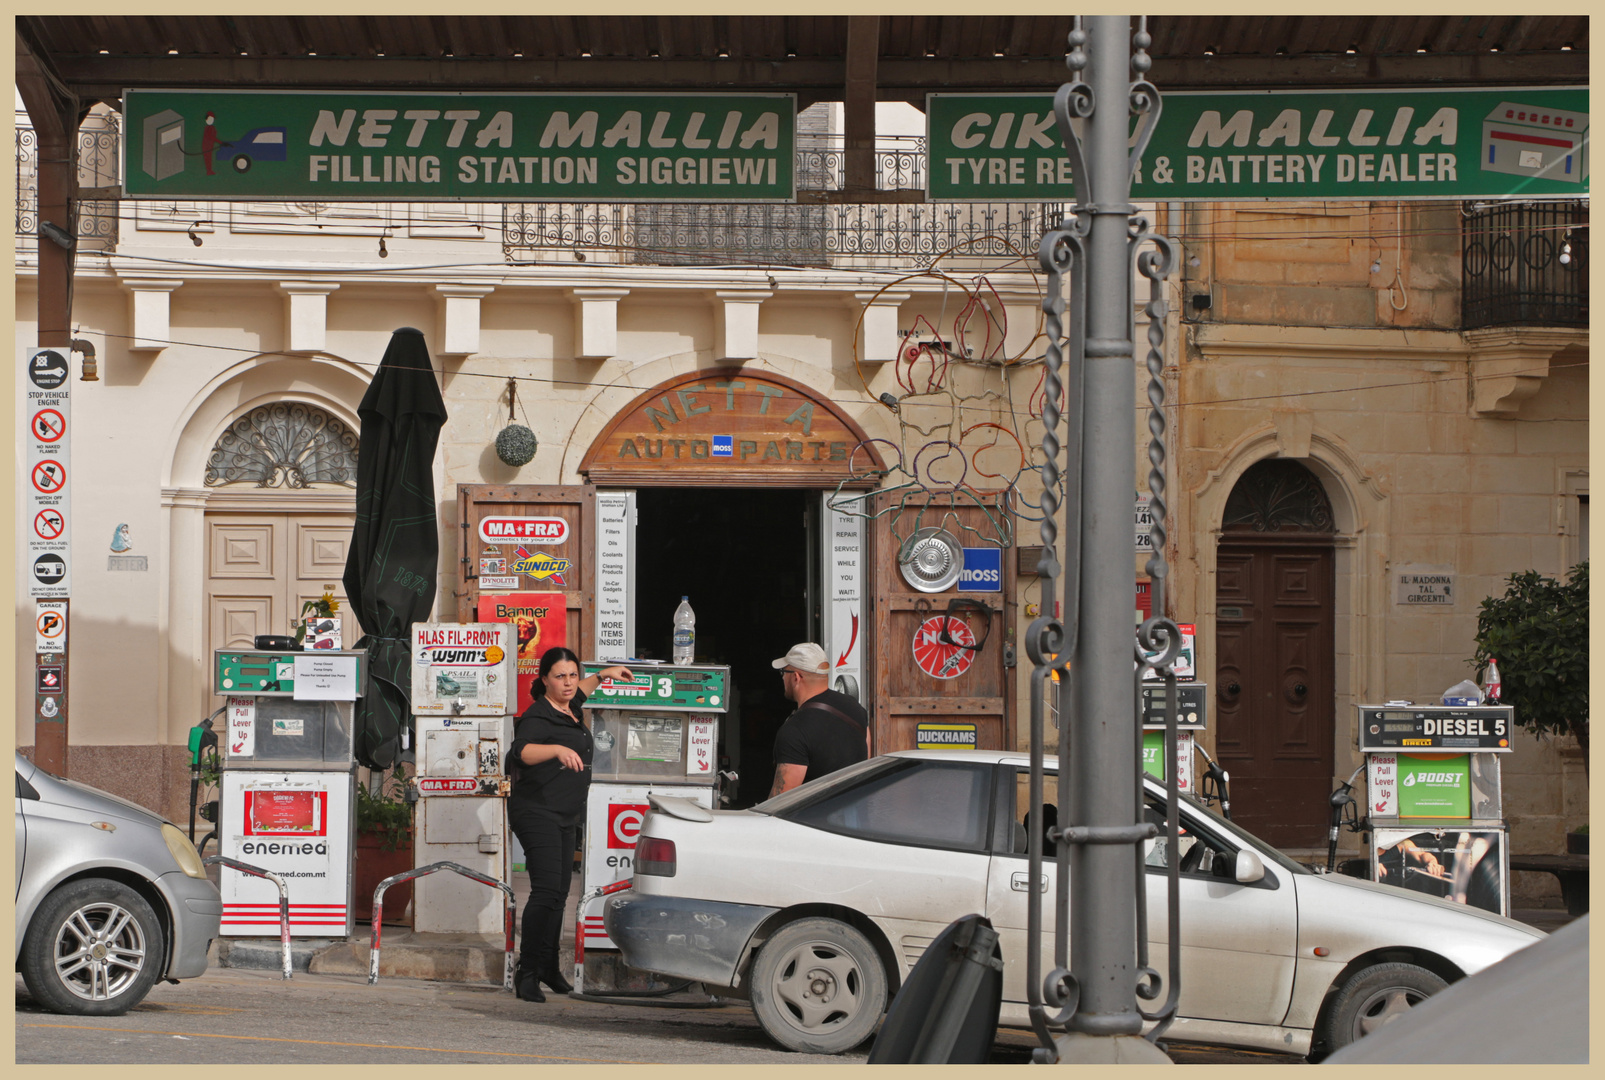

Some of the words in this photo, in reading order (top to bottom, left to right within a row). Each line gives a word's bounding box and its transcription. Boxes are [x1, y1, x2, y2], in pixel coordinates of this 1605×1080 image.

[308, 110, 513, 148] NETTA
[539, 110, 779, 149] MALLIA
[1187, 107, 1458, 147] MALLIA
[308, 155, 440, 182] FILLING
[458, 156, 597, 184] STATION
[615, 157, 777, 185] SIGGIEWI
[945, 158, 1025, 185] TYRE
[1036, 157, 1142, 184] RER
[1152, 156, 1174, 184] &
[1187, 154, 1326, 183] BATTERY
[1336, 153, 1457, 182] DEALER
[643, 381, 815, 436] NETTA
[618, 438, 709, 459] AUTO
[740, 440, 847, 461] PARTS
[713, 444, 732, 452] moss
[1135, 535, 1150, 546] .28
[515, 561, 566, 571] SUNOCO
[959, 569, 999, 582] moss
[1412, 576, 1451, 584] MADONNA
[393, 566, 428, 596] 1873
[1419, 585, 1434, 593] TAL
[496, 604, 549, 618] Banner
[601, 621, 623, 629] MORE
[418, 630, 445, 645] HLAS
[448, 630, 500, 645] FIL-PRONT
[517, 667, 540, 675] ERVIC
[658, 678, 672, 698] 3
[231, 698, 254, 706] Please
[690, 715, 713, 724] Please
[695, 726, 707, 734] Pull
[1423, 719, 1489, 736] DIESEL
[1494, 719, 1506, 736] 5
[238, 731, 248, 740] Up
[917, 731, 976, 743] DUCKHAMS
[692, 737, 710, 745] Lever
[697, 749, 707, 758] Up
[1372, 756, 1396, 764] Please
[1378, 767, 1391, 775] Pull
[1375, 778, 1394, 786] Lever
[1417, 773, 1464, 783] BOOST
[1381, 790, 1391, 799] Up
[243, 840, 327, 855] enemed
